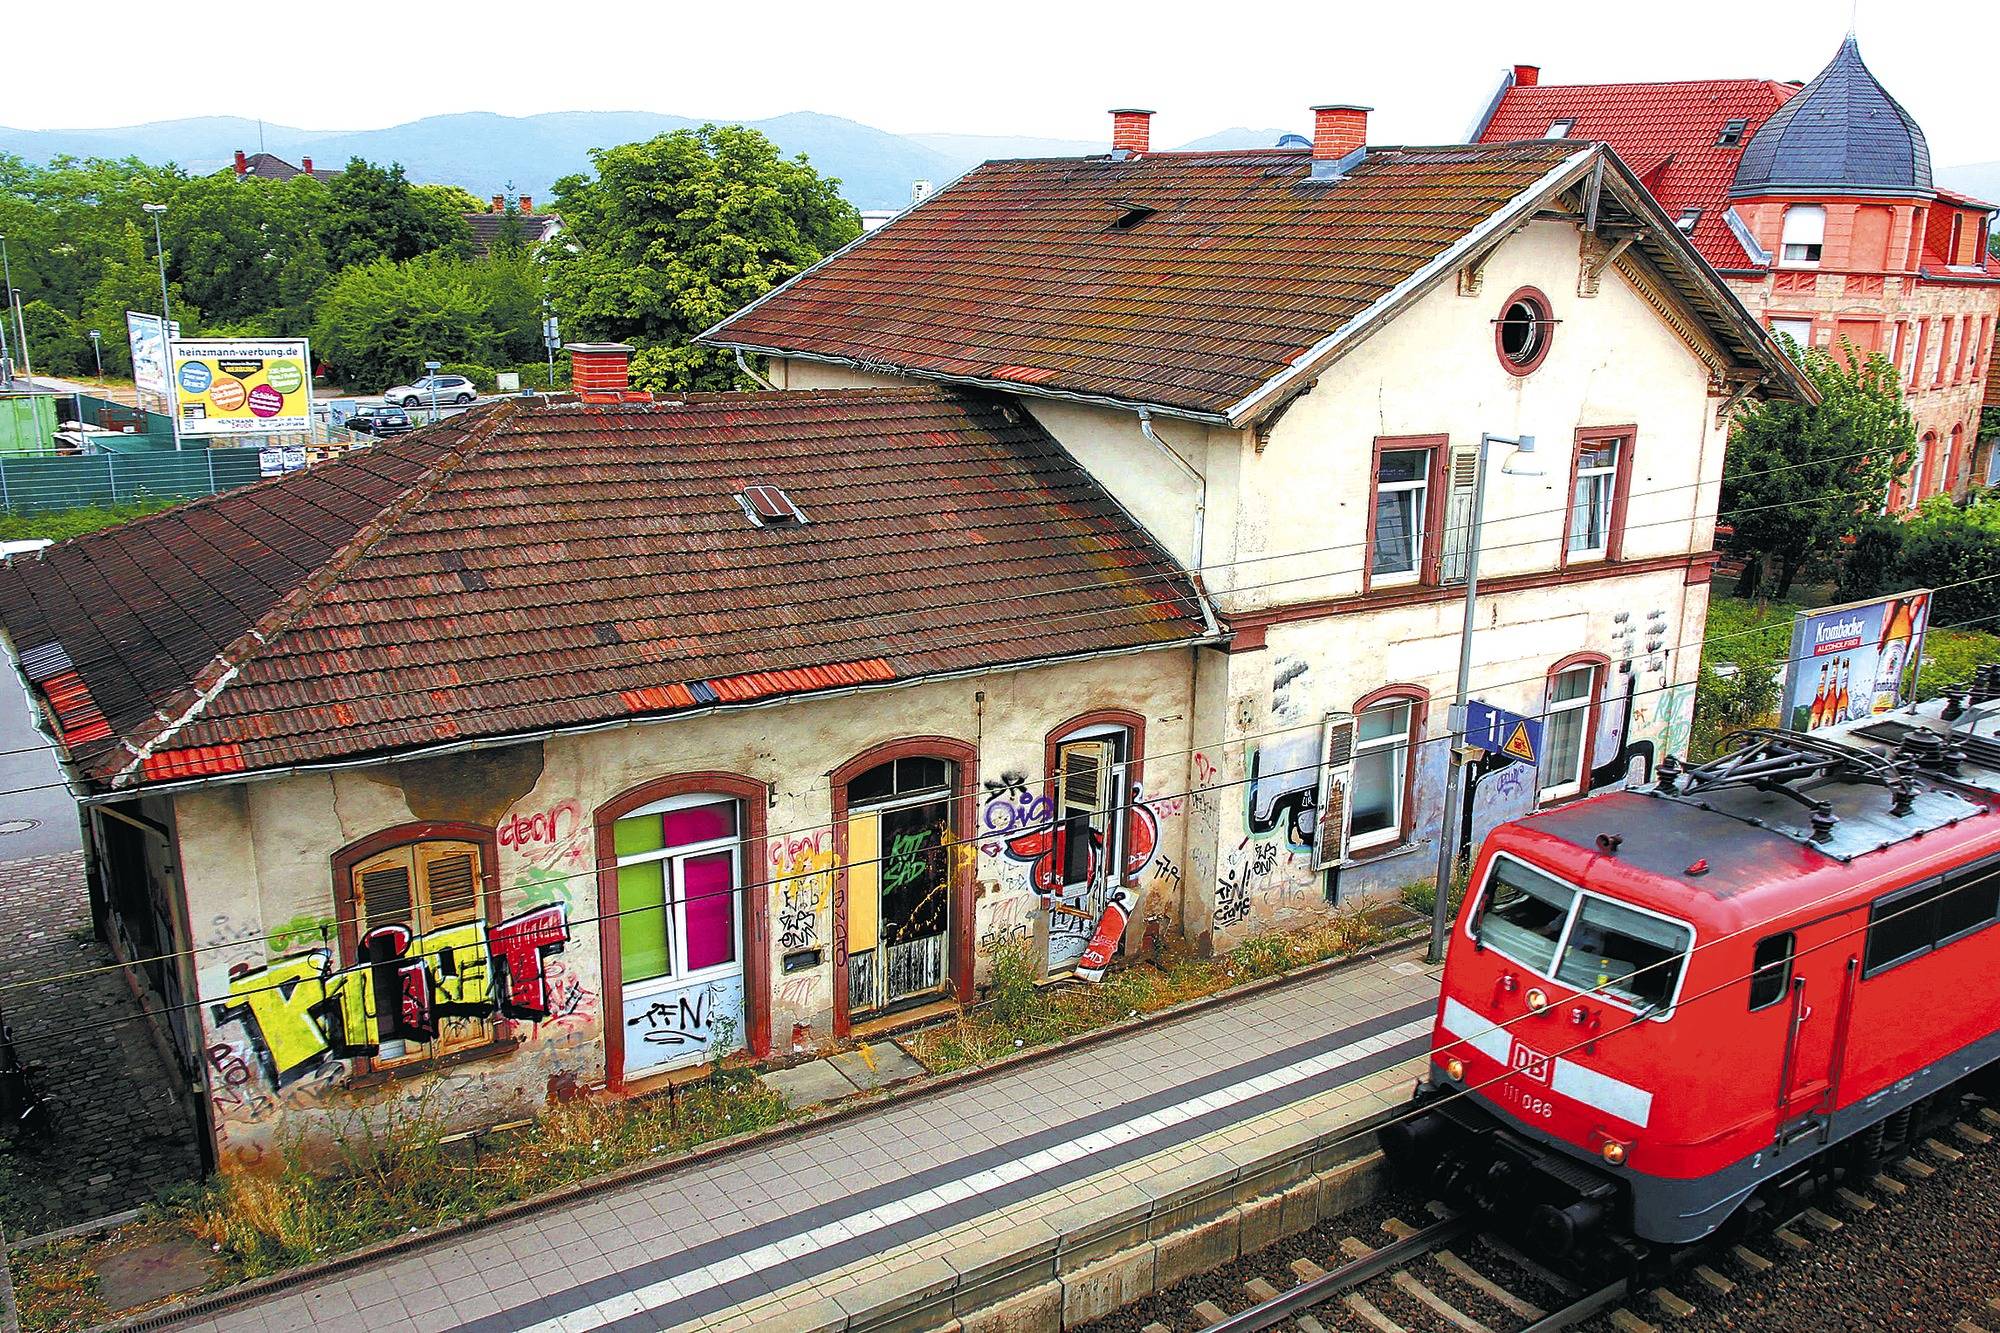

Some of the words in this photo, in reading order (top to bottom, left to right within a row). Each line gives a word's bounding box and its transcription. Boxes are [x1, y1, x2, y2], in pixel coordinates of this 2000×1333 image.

[179, 347, 298, 357] heinzmann-werbung.de
[1815, 616, 1865, 643] Krombacher
[1485, 710, 1497, 743] 1
[1503, 1082, 1519, 1103] 111
[1522, 1094, 1552, 1118] 086
[1752, 1152, 1762, 1169] 2
